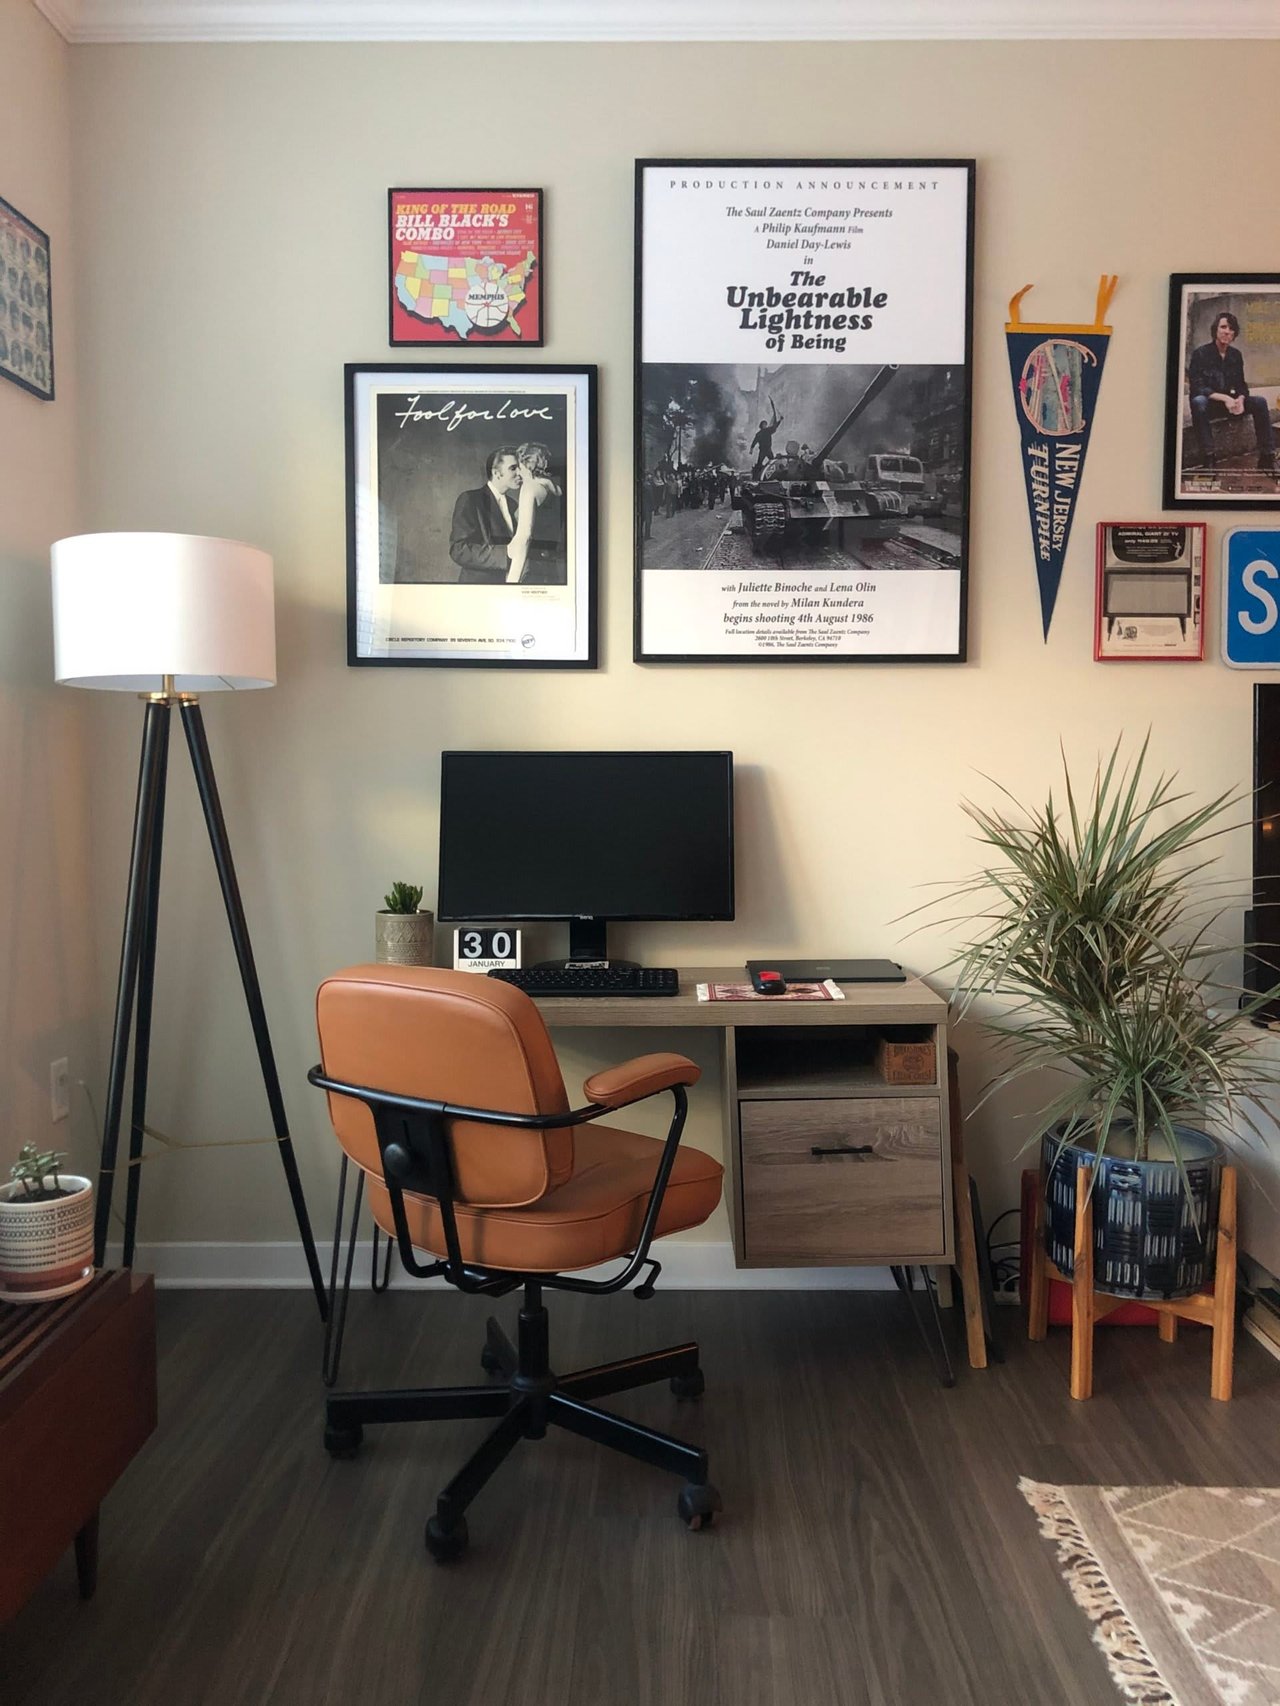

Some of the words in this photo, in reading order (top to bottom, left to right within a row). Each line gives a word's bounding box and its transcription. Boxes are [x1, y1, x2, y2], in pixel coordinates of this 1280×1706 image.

[671, 181, 783, 189] PRODUCTION
[797, 182, 938, 190] ANNOUNCEMENT
[396, 204, 428, 214] KING
[431, 204, 448, 214] OF
[451, 204, 478, 214] THE
[480, 204, 516, 214] ROAD
[726, 207, 743, 217] The
[745, 207, 767, 217] Saul
[769, 207, 801, 217] Zaentz
[805, 207, 851, 220] Company
[853, 208, 892, 217] Presents
[396, 214, 434, 227] BILL
[438, 214, 509, 227] BLACK'S
[395, 227, 455, 241] COMBO
[762, 223, 791, 236] Philip
[794, 223, 845, 236] Kaufmann
[767, 239, 799, 249] Daniel
[801, 239, 851, 252] Day-Lewis
[804, 256, 813, 264] in
[790, 271, 826, 286] The
[468, 293, 504, 302] MEMPHIS
[727, 285, 888, 309] Unbearable
[738, 307, 873, 334] Lightness
[765, 333, 786, 353] of
[790, 334, 847, 353] Being
[395, 394, 455, 429] Fool
[447, 403, 494, 431] for
[496, 399, 553, 420] Love
[1055, 442, 1082, 489] NEW
[1027, 441, 1051, 561] TURNPIKE
[1052, 490, 1072, 551] JERSEY
[738, 582, 772, 593] Juliette
[775, 582, 812, 592] Binoche
[830, 583, 853, 592] Lena
[856, 582, 876, 592] Olin
[732, 600, 749, 609] from
[781, 600, 789, 609] by
[791, 598, 820, 607] Milan
[822, 598, 864, 607] Kundera
[1237, 559, 1279, 635] S
[724, 613, 752, 625] begins
[755, 613, 795, 625] shooting
[798, 613, 813, 622] 4th
[815, 614, 848, 625] August
[852, 614, 874, 623] 1986
[847, 629, 870, 637] Company
[468, 960, 506, 968] JANUARY
